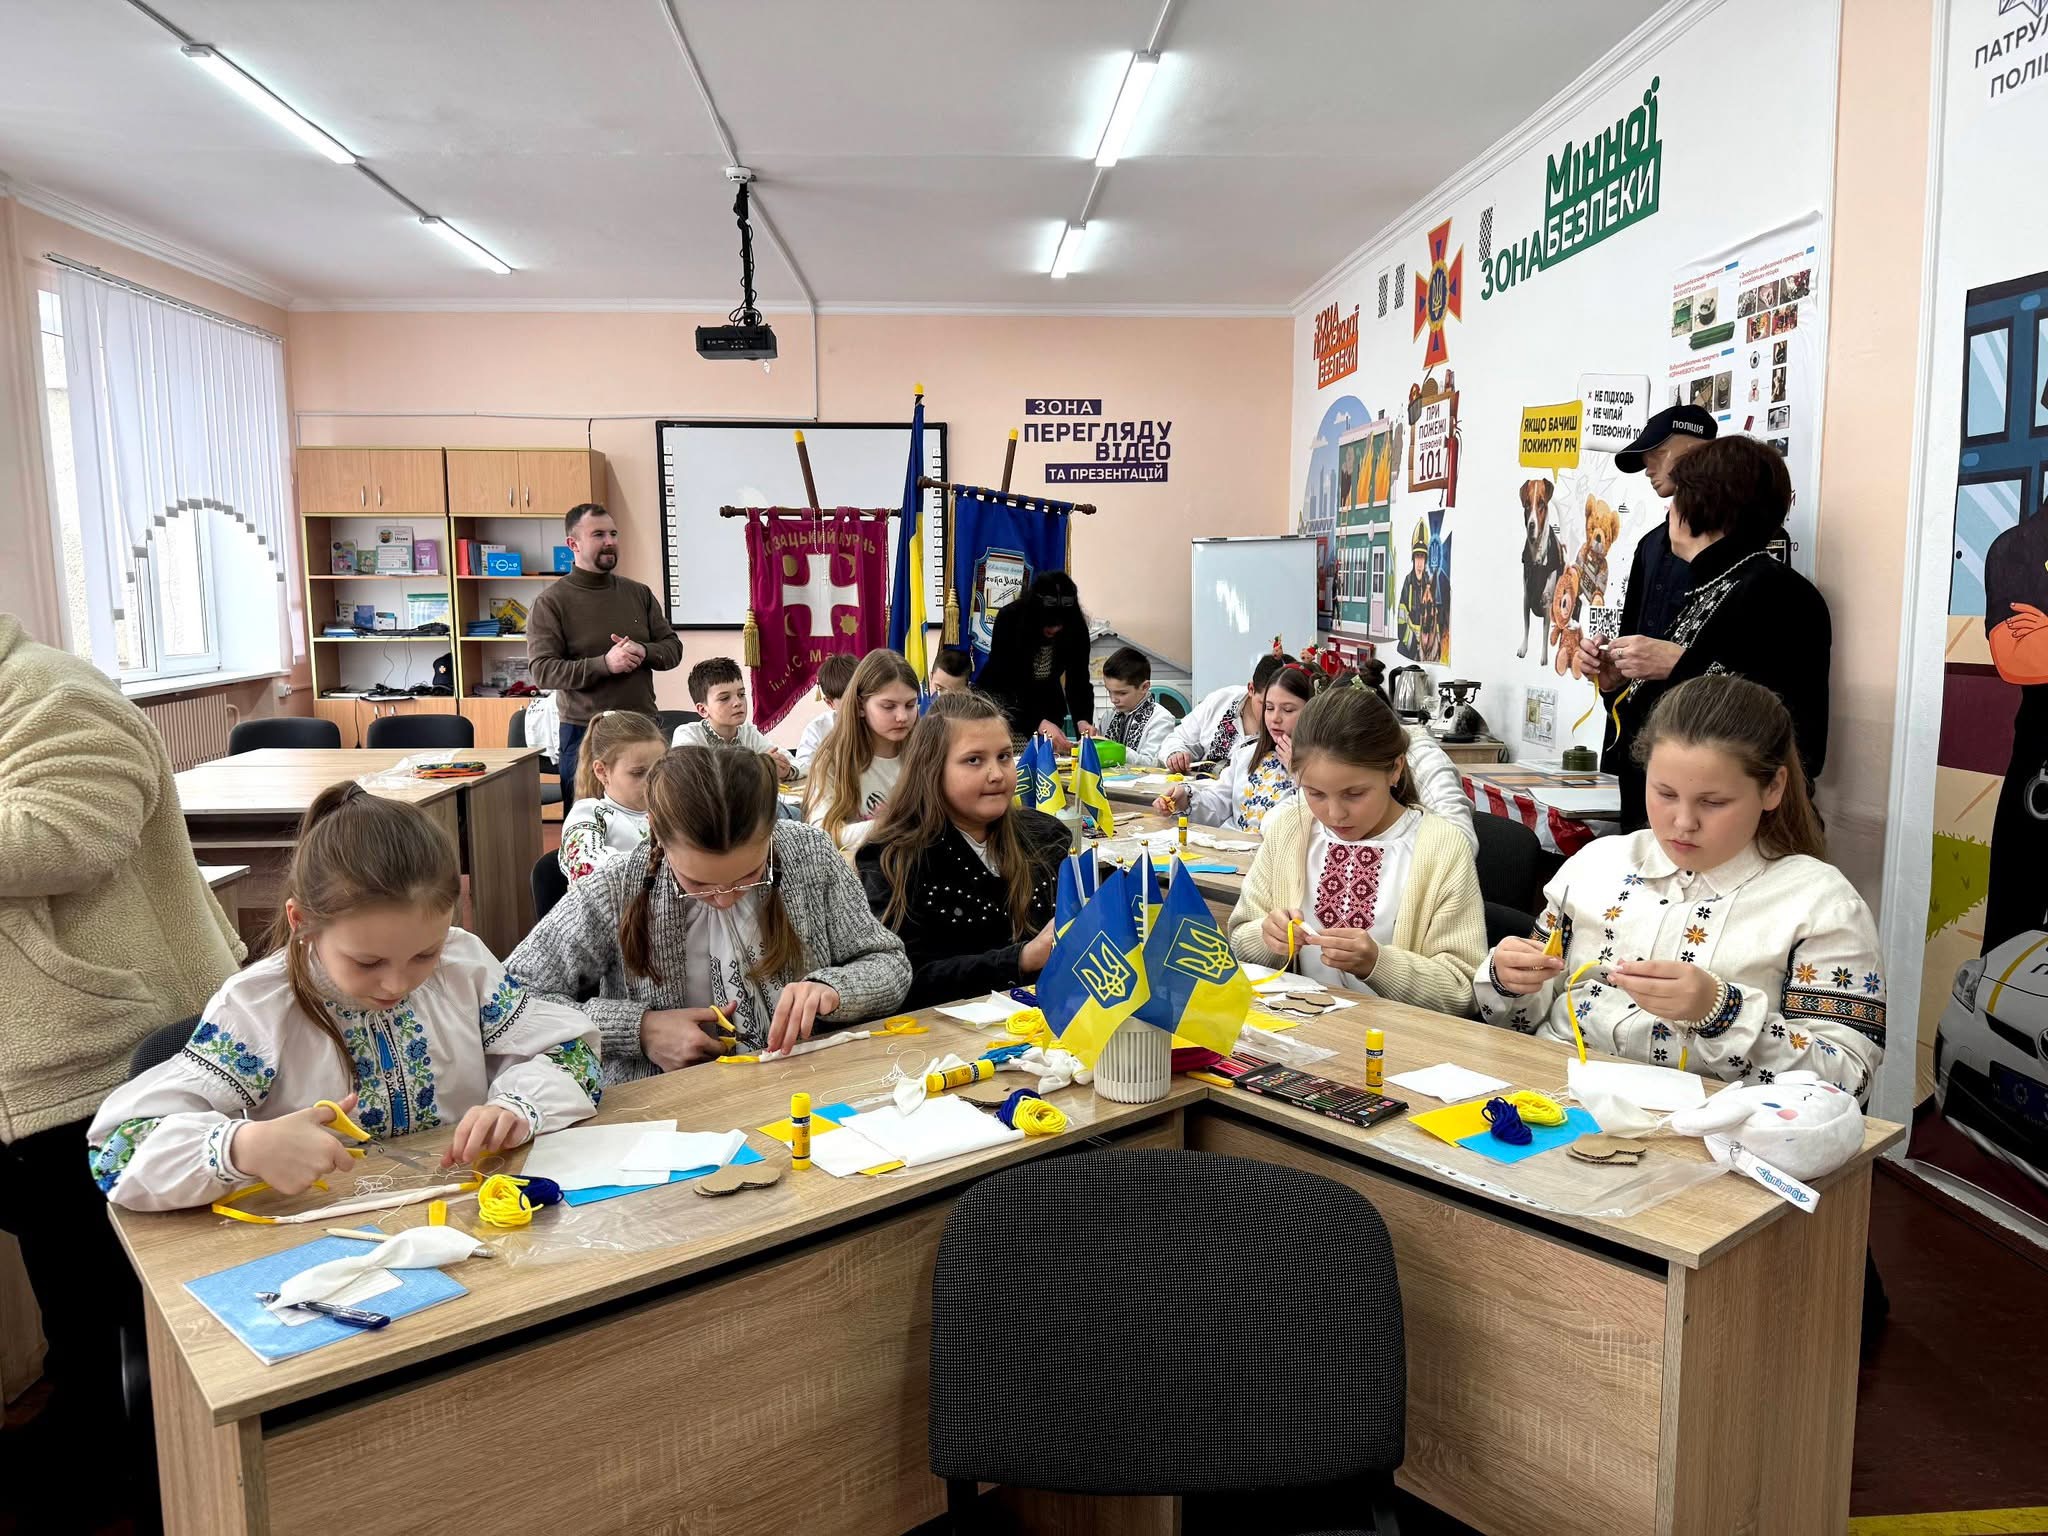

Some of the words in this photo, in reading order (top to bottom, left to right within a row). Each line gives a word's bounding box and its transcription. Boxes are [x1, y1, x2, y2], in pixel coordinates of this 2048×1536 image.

[1547, 76, 1662, 208] МІННОЇ
[1481, 229, 1545, 300] ЗОНА
[1546, 157, 1656, 259] БЕЗПЕКИ
[1315, 302, 1339, 336] ЗОНА
[1320, 346, 1356, 384] БЕЗПЕКИ
[1594, 390, 1603, 402] НЕ
[1604, 391, 1634, 405] ПІДХОДЬ
[1034, 400, 1094, 415] ЗОНА
[1426, 404, 1440, 421] ПРИ
[1593, 407, 1602, 418] НЕ
[1603, 406, 1623, 420] ЧІПАЙ
[1024, 421, 1172, 443] ПЕРЕГЛЯДУ
[1524, 417, 1546, 435] ЯКЩО
[1548, 415, 1577, 431] БАЧИШ
[1592, 424, 1632, 440] ТЕЛЕФОНУЙ
[1633, 428, 1643, 440] 10
[1672, 420, 1704, 434] ПОЛІЦІЯ
[1096, 441, 1171, 464] ВІДЕО
[1419, 437, 1442, 451] ТЕЛЕФОНУЙ
[1522, 438, 1562, 453] ПОКИНУТУ
[1564, 438, 1577, 453] РІЧ
[1049, 469, 1066, 480] ТА
[1070, 464, 1163, 481] ПРЕЗЕНТАЦІЙ
[1419, 449, 1442, 481] 101
